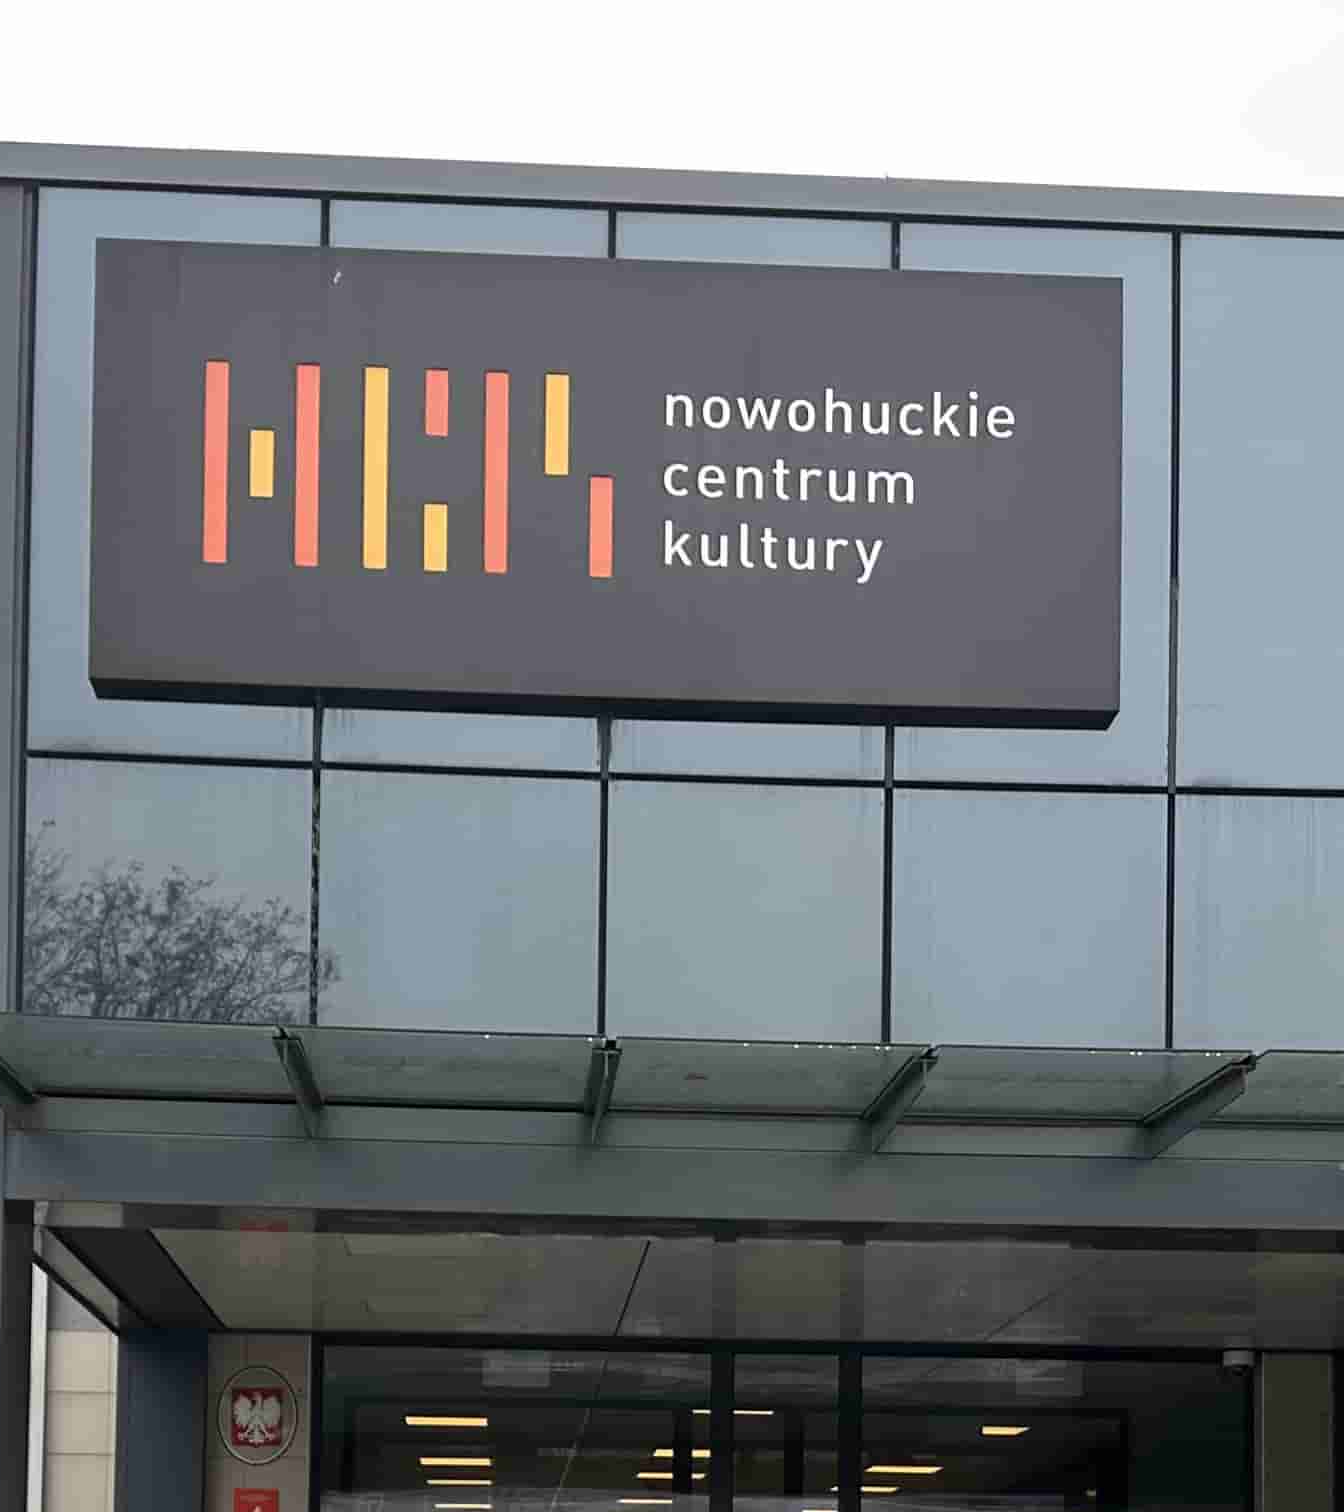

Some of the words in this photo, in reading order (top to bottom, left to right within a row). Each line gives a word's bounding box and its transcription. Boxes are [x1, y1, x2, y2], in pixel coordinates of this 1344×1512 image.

[665, 387, 1017, 439] nowohuckie
[663, 458, 916, 504] centrum
[664, 519, 884, 584] kultury
